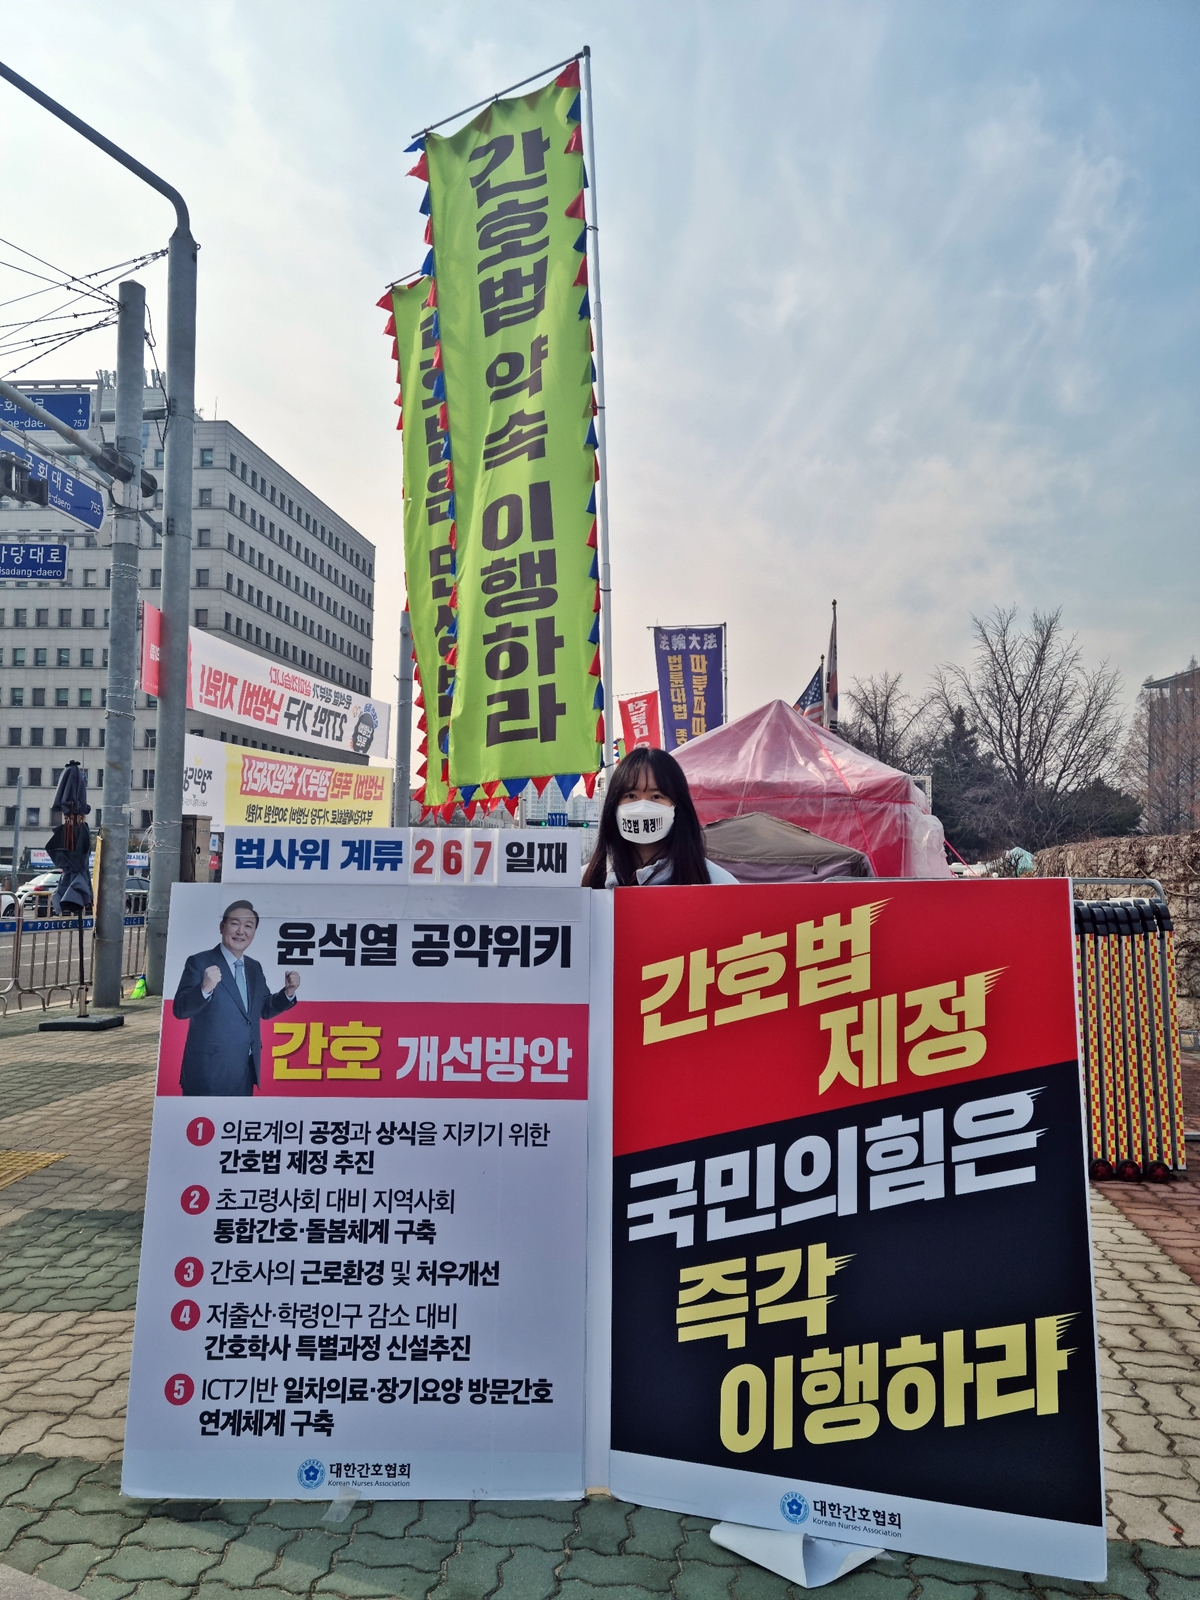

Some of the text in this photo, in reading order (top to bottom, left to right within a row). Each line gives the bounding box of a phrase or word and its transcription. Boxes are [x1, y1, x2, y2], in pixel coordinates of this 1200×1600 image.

[73, 419, 87, 428] 757
[469, 127, 567, 748] 간호법 약속 이행하라
[90, 500, 101, 515] 755
[658, 632, 718, 651] 法輪大法
[622, 816, 664, 834] 간호법 제정!!!
[234, 838, 567, 875] 법사위 계류 267 일째
[37, 920, 73, 930] POLICE
[277, 921, 572, 968] 윤석열 공약위키
[641, 897, 888, 1046] 간호법
[818, 966, 1006, 1097] 제정
[271, 1020, 573, 1084] 간호 개선방안
[220, 1119, 304, 1146] 의료계의
[308, 1120, 372, 1146] 공정과
[375, 1120, 438, 1147] 상식을
[442, 1121, 504, 1148] 지키기
[508, 1121, 551, 1148] 위한
[218, 1149, 375, 1176] 간호법 제정 추진
[627, 1086, 1048, 1250] 국민의힘은
[214, 1187, 322, 1214] 초고령사회
[325, 1187, 367, 1213] 대비
[372, 1187, 456, 1215] 지역사회
[213, 1218, 437, 1245] 통합간호·돌봄체계 구축
[209, 1259, 296, 1286] 간호사의
[300, 1259, 385, 1287] 근로환경
[390, 1259, 411, 1287] 및
[415, 1260, 500, 1287] 처우개선
[676, 1242, 852, 1350] 즉각
[206, 1301, 363, 1331] 저출산·학령인구
[367, 1302, 411, 1330] 감소
[415, 1302, 458, 1330] 대비
[204, 1333, 471, 1363] 간호학사 특별과정 신설추진
[201, 1375, 279, 1404] ICT기반
[283, 1376, 463, 1405] 일차의료·장기요양
[467, 1377, 554, 1406] 방문간호
[720, 1312, 1078, 1454] 이행하라
[198, 1408, 336, 1438] 연계체계 구축
[329, 1462, 411, 1479] 대한간호협회
[374, 1480, 411, 1488] Association
[812, 1517, 902, 1539] Korean Nurses Association
[813, 1500, 902, 1530] 대한간호협회
